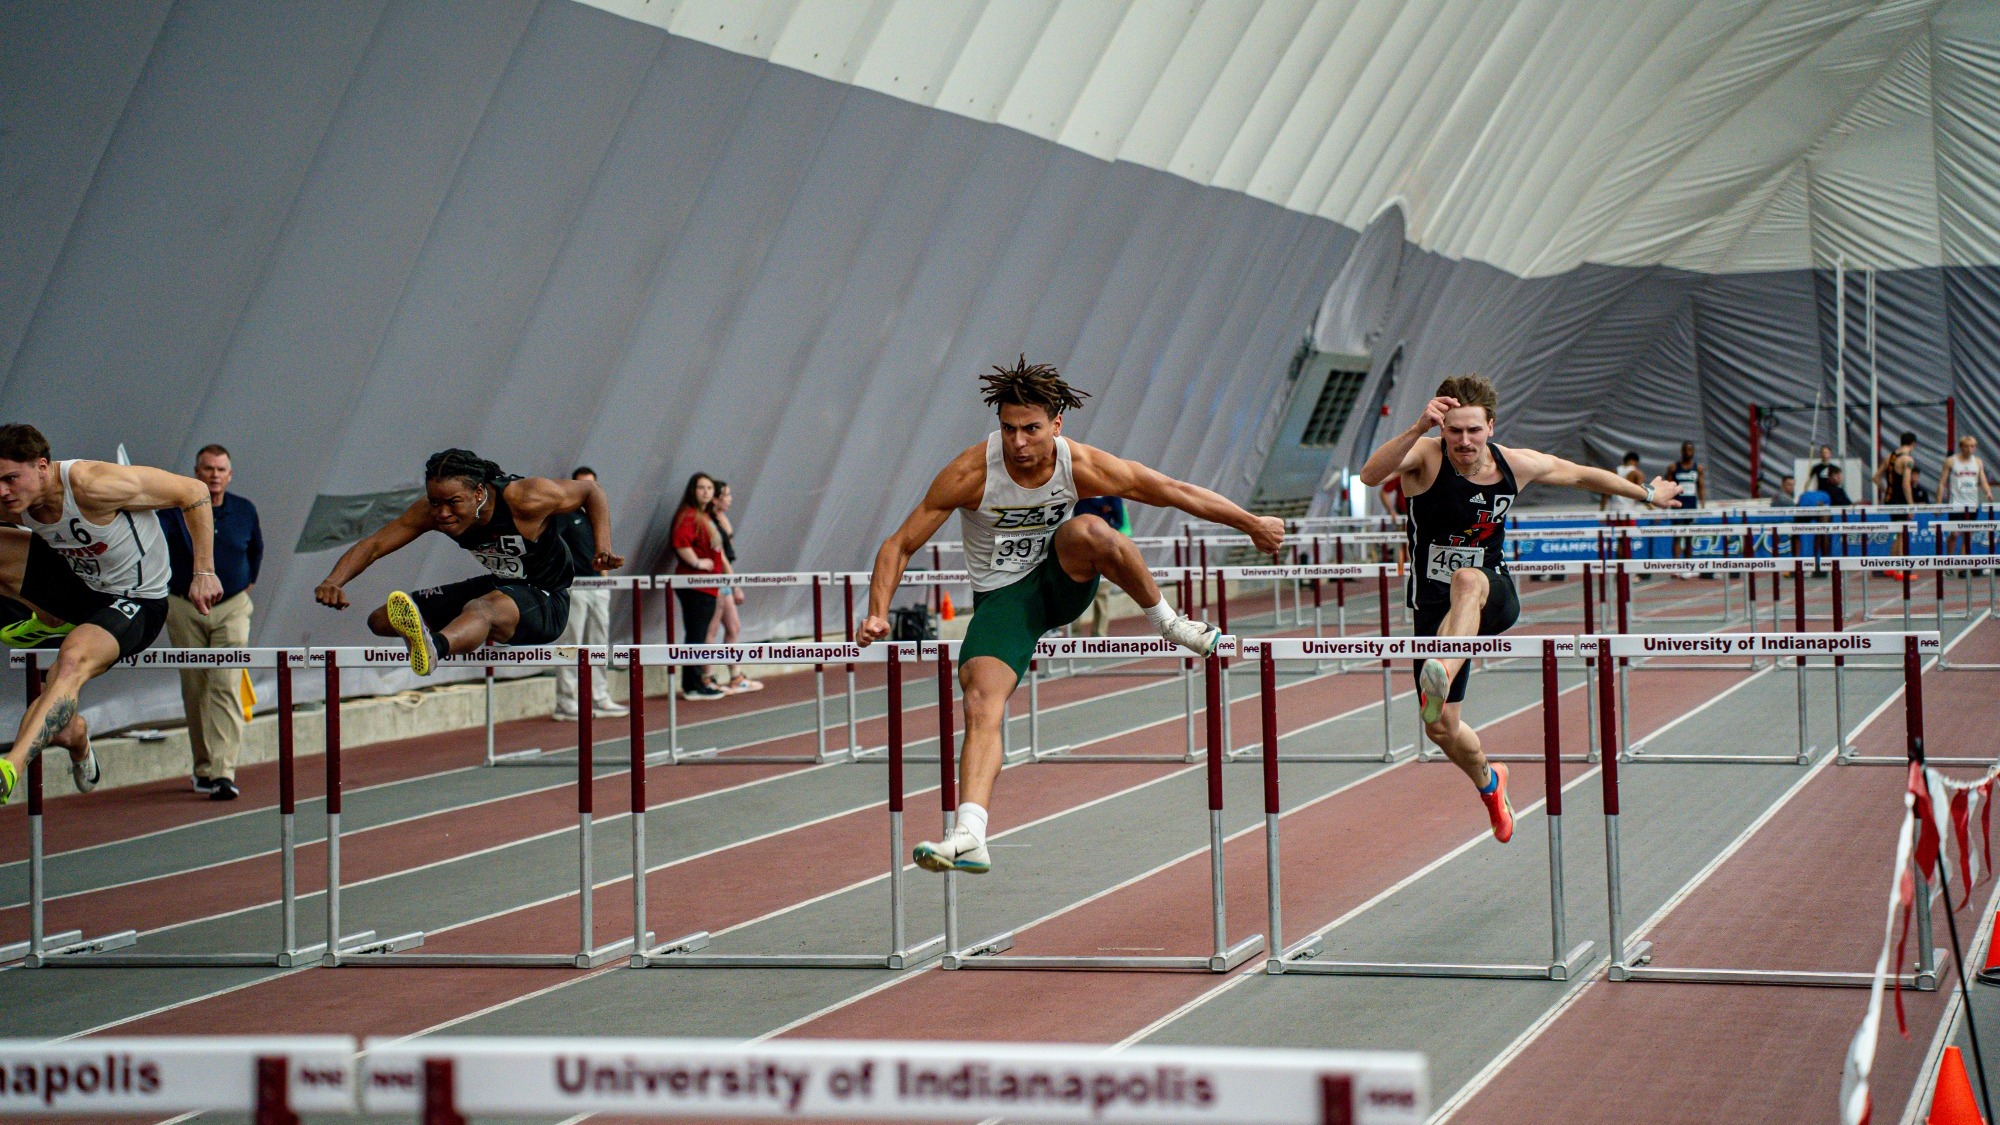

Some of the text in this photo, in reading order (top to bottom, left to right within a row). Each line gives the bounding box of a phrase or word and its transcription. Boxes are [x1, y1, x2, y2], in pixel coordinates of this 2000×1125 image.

[1046, 502, 1068, 526] 3
[1493, 497, 1511, 523] 2
[69, 517, 91, 545] 6
[502, 537, 522, 557] 5
[998, 536, 1047, 559] 391
[1432, 550, 1476, 573] 461
[1507, 563, 1566, 573] ndianapolis
[1643, 560, 1776, 571] University of Indianapolis
[1860, 557, 2000, 569] University of Indianapolis
[687, 575, 797, 586] University of Indianapolis
[926, 573, 969, 584] Indianapo
[1241, 566, 1363, 578] University of Indianapolis
[1061, 641, 1077, 654] of
[1081, 639, 1178, 656] Indianapolis
[1302, 639, 1512, 657] University of Indianapolis
[1643, 635, 1872, 653] University of Indianapolis
[143, 651, 158, 664] of
[163, 650, 251, 668] Indianapolis
[364, 649, 410, 662] Univer
[463, 648, 552, 664] Indianapolis
[668, 645, 861, 663] University of Indianapolis
[552, 1055, 1217, 1114] University of Indianapolis
